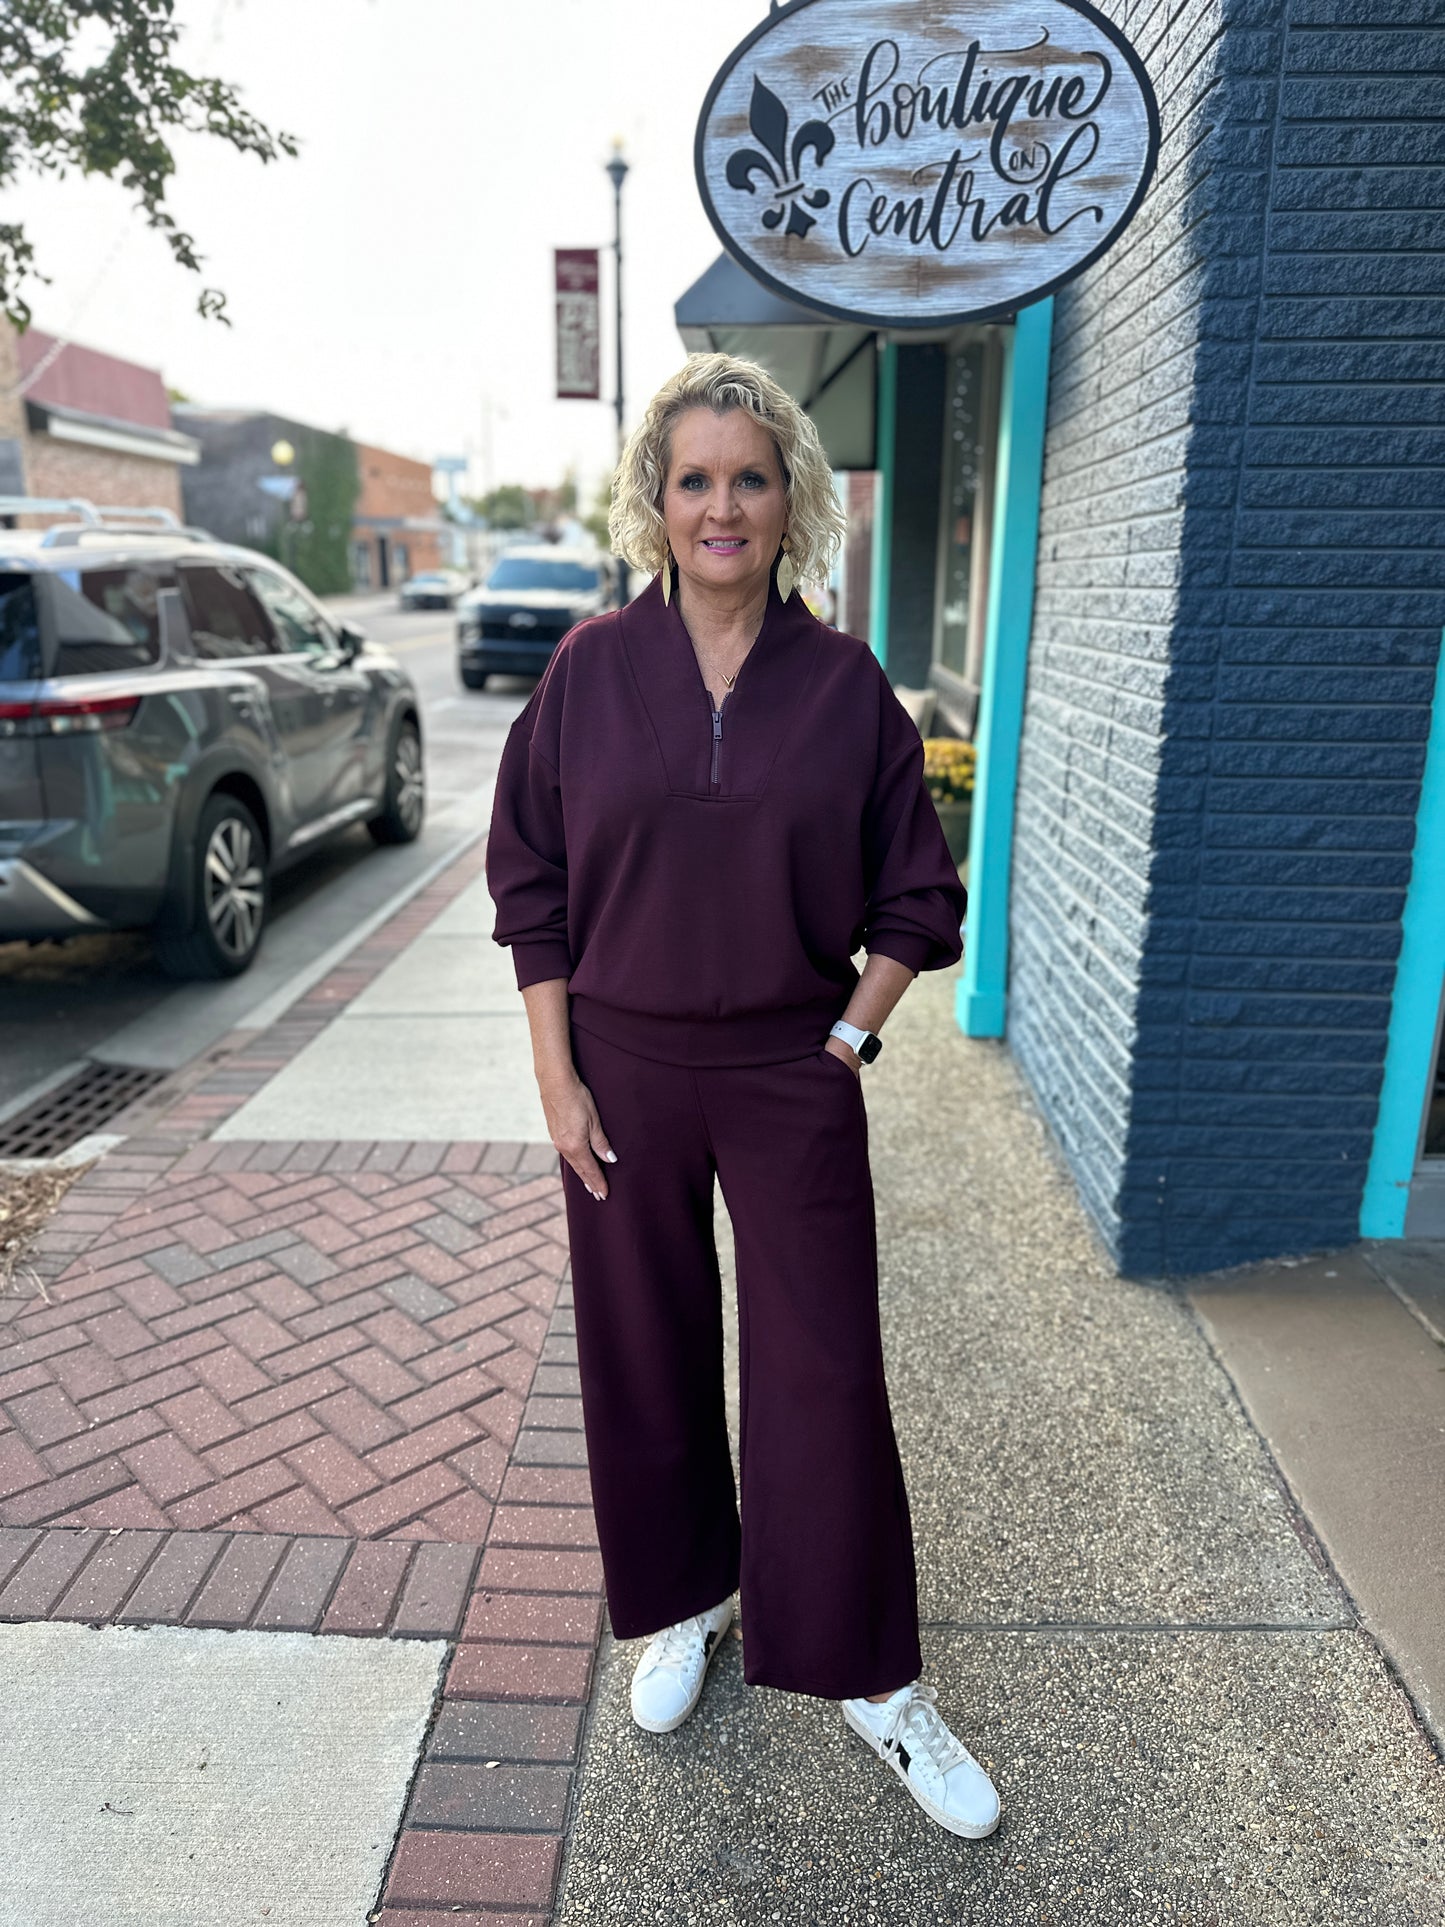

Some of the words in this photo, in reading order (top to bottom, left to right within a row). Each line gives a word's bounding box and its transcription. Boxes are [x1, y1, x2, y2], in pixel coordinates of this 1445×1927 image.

[812, 77, 851, 113] THE
[850, 27, 1111, 183] boutique
[1009, 147, 1035, 171] ON
[838, 122, 1103, 257] Central
